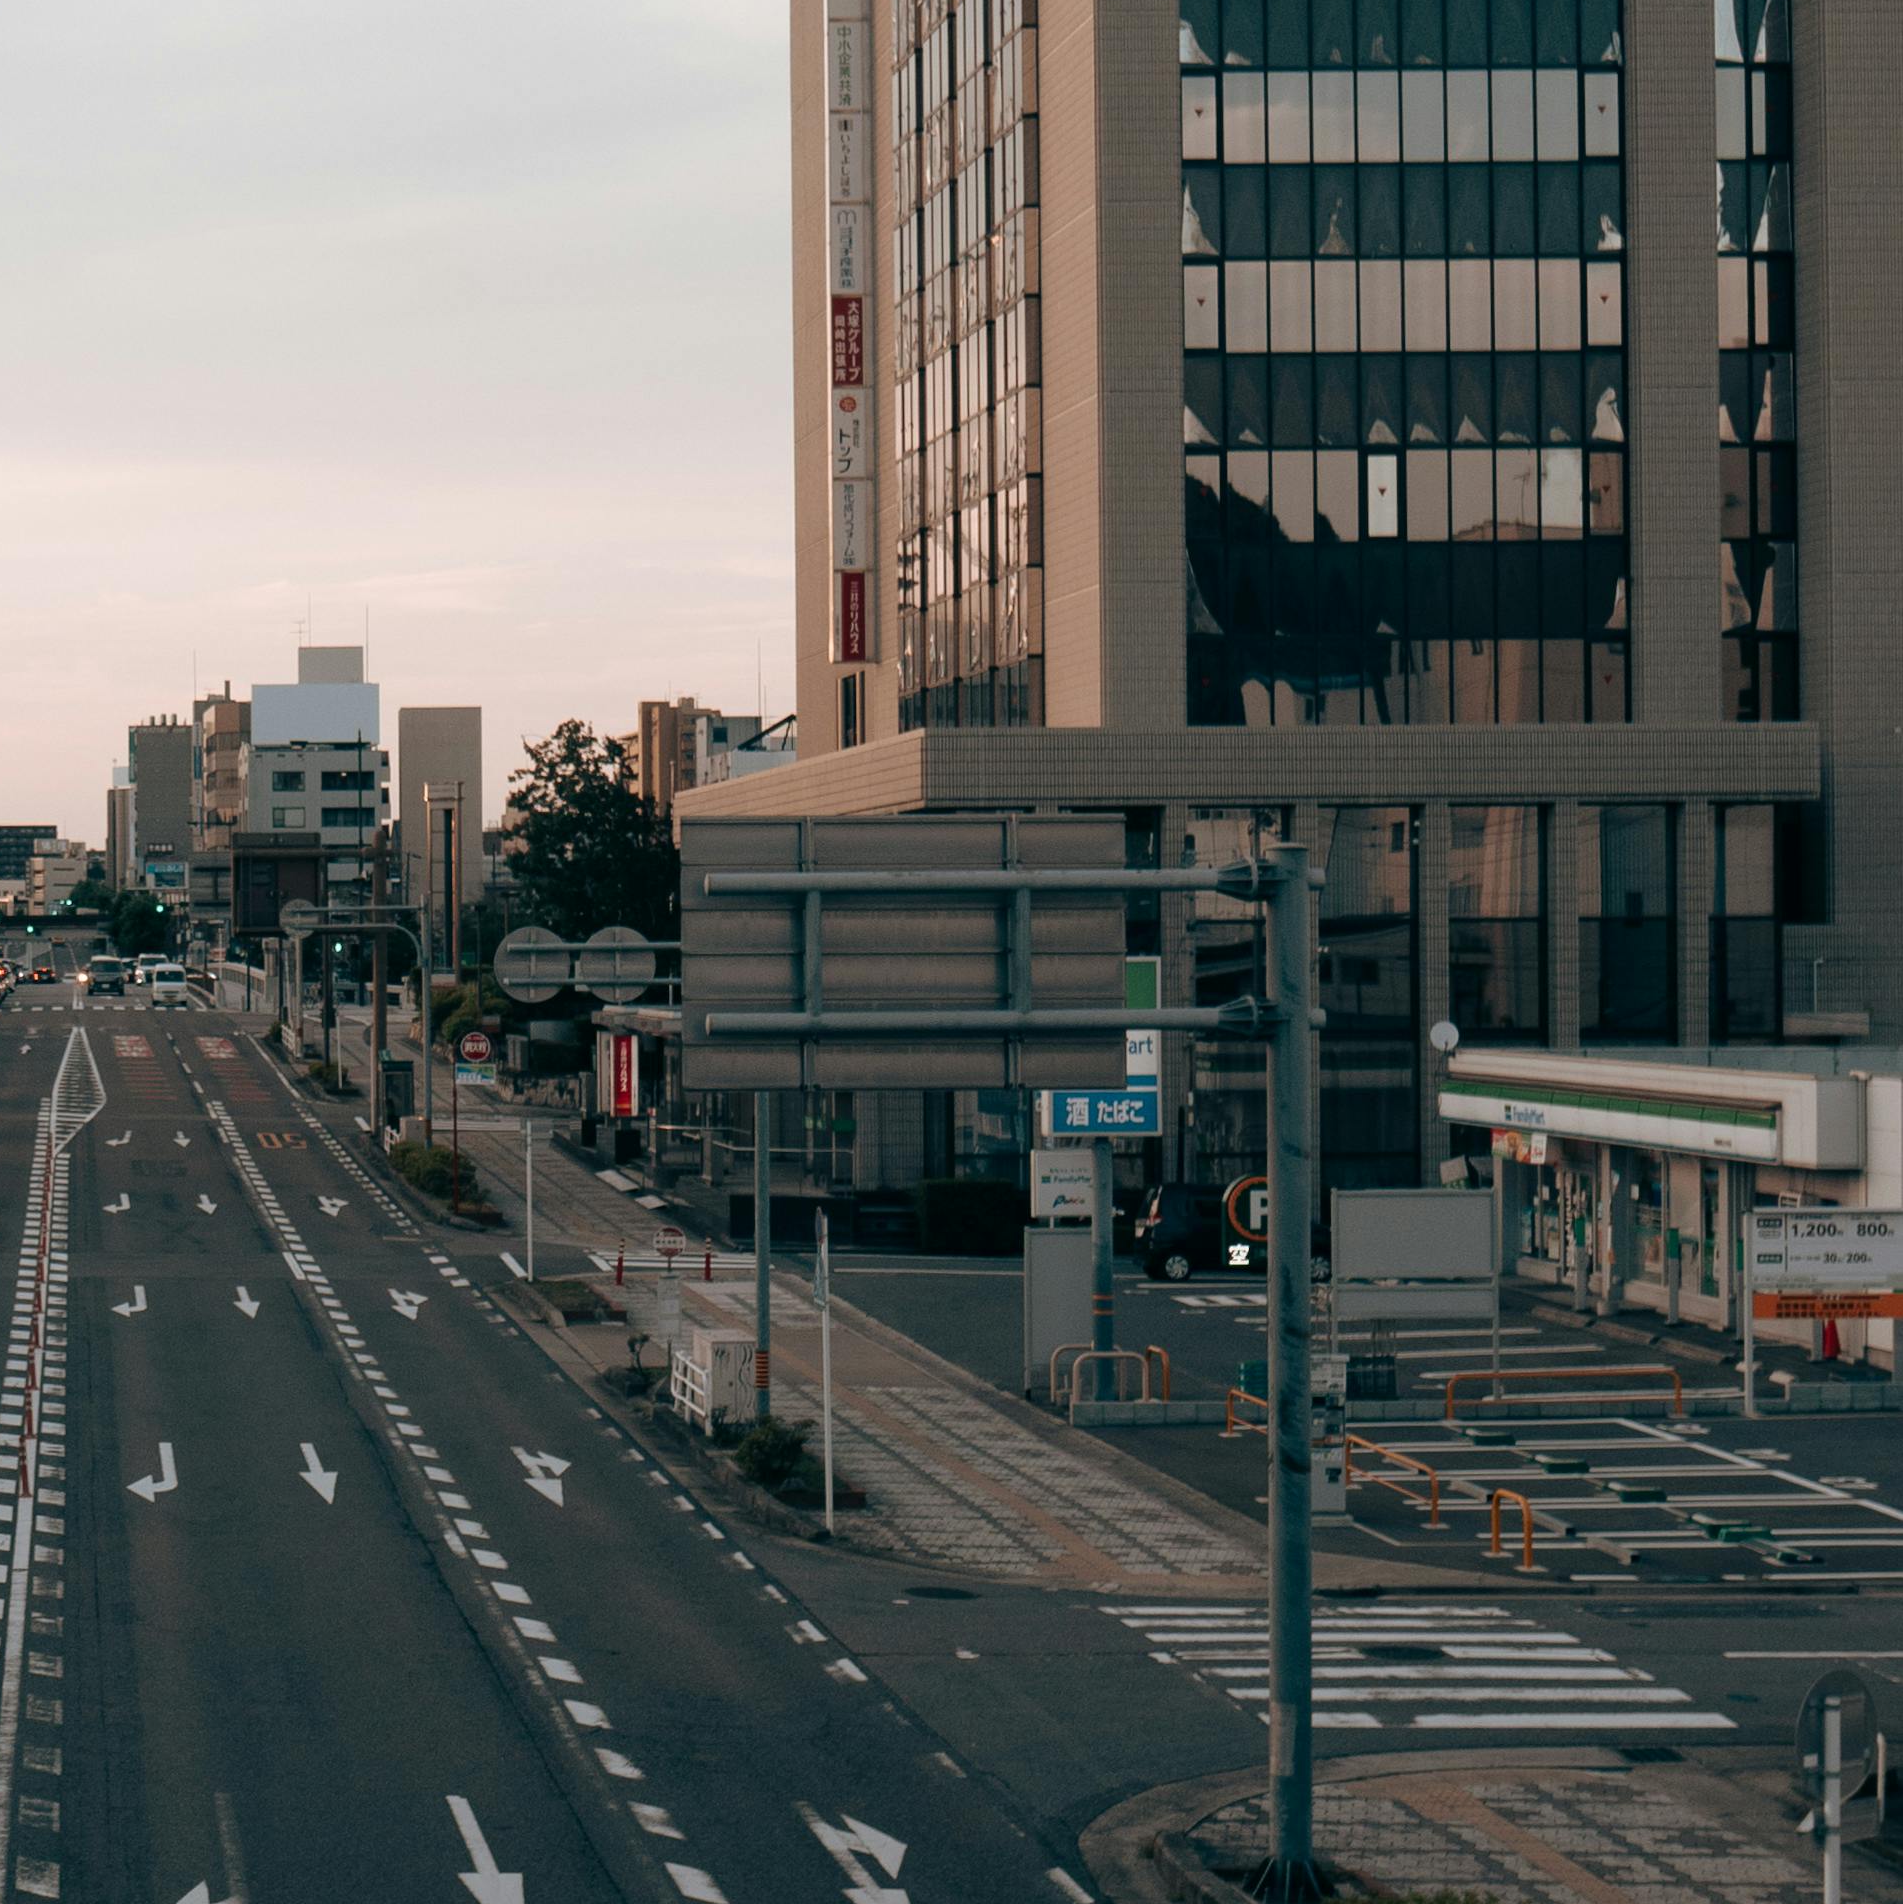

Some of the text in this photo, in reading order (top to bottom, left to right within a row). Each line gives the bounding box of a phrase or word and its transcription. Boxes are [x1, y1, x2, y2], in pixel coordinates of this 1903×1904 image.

[837, 25, 851, 106] 中小企業共済
[848, 301, 861, 381] 大塚グループ
[838, 428, 853, 474] トップ
[850, 581, 859, 654] 三井のリハウス
[1066, 1097, 1145, 1127] 酒 たばこ
[1054, 1176, 1092, 1184] FamilyMar
[1228, 1243, 1250, 1266] 空
